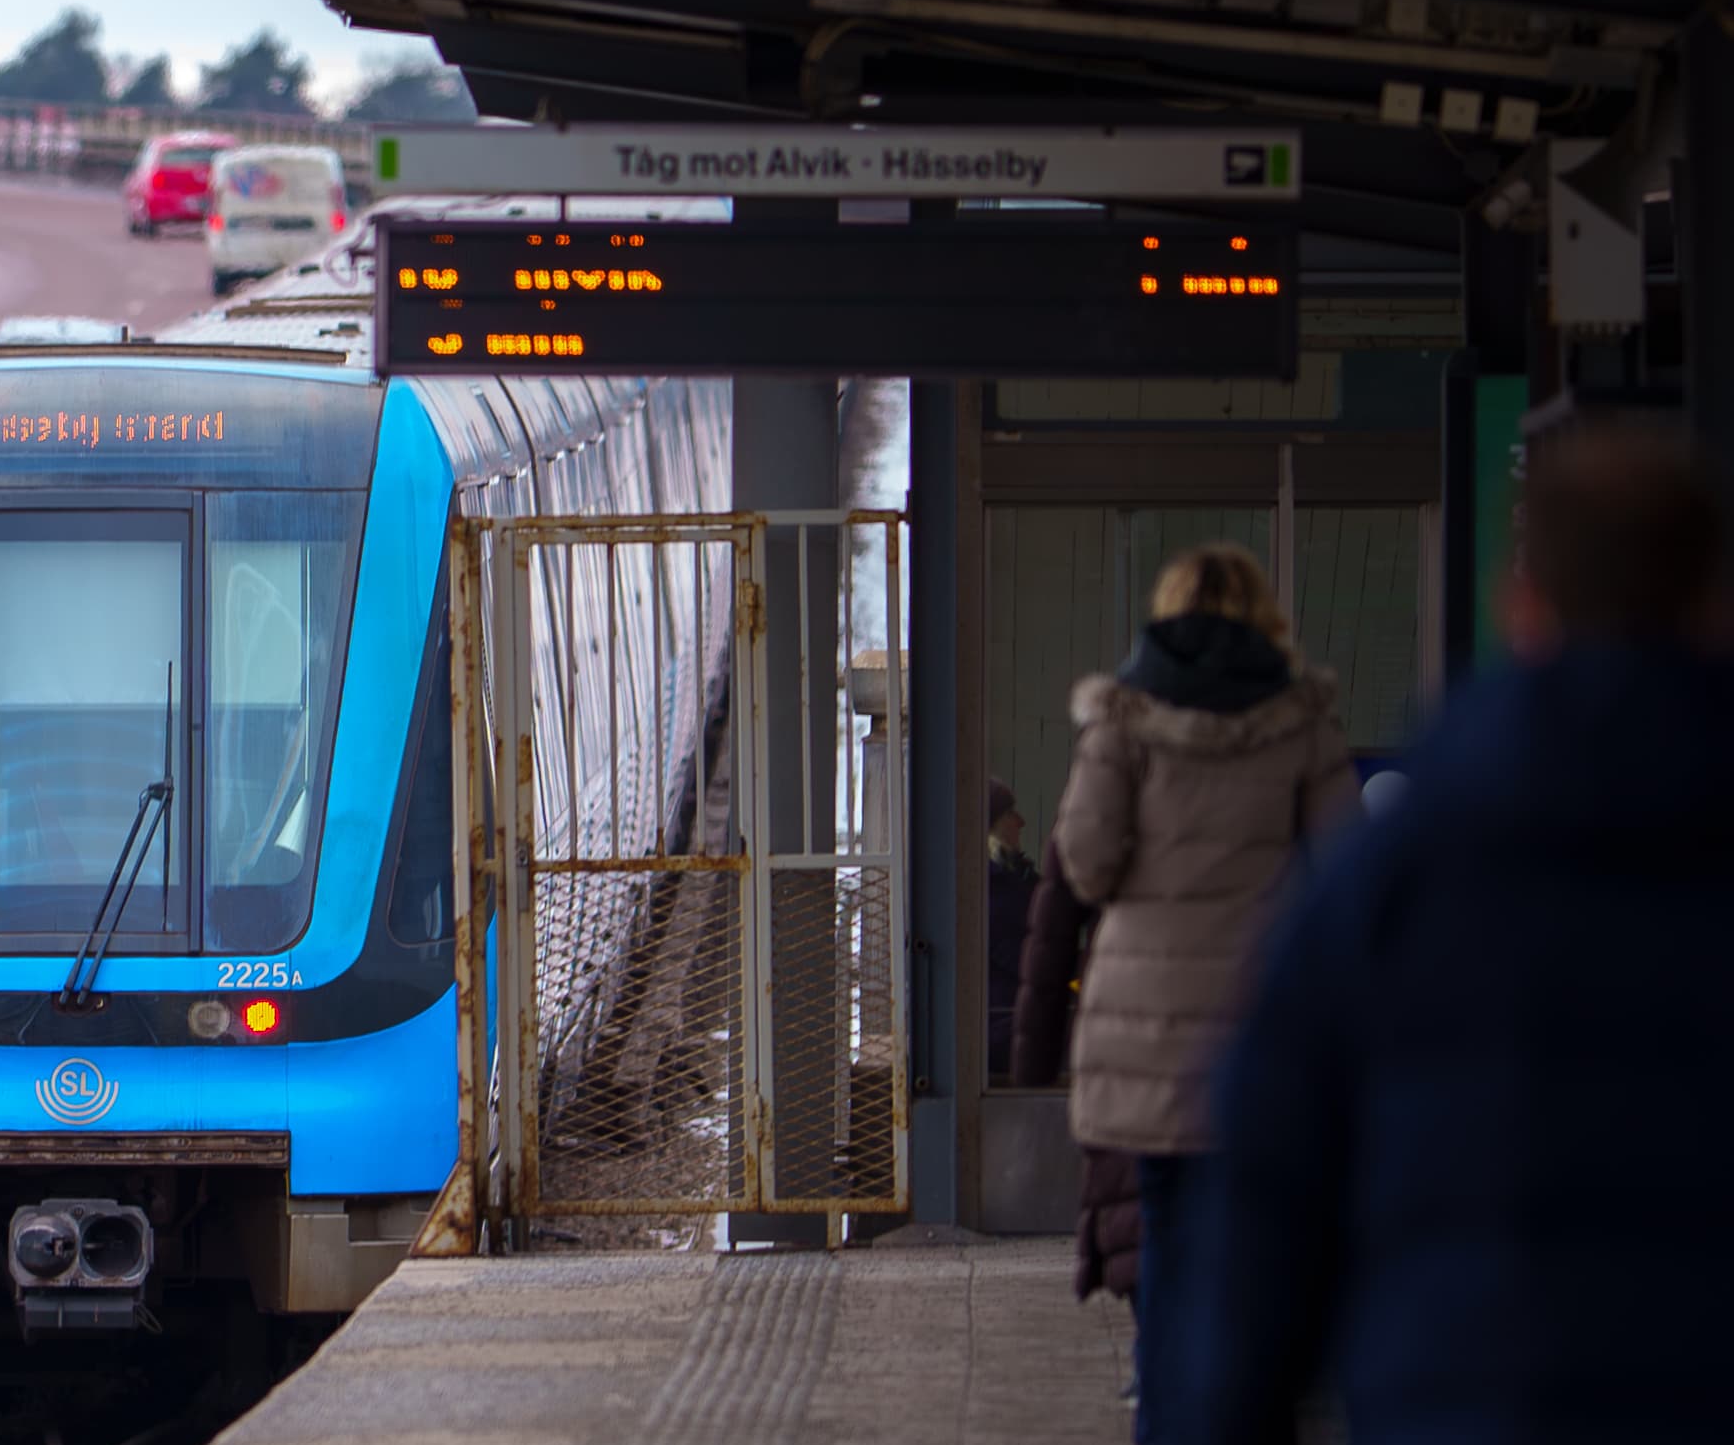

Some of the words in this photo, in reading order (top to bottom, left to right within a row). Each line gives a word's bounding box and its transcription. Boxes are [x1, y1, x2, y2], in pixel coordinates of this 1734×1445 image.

[615, 145, 681, 183] Tåg
[690, 148, 757, 177] mot
[764, 146, 851, 177] Alvik
[882, 146, 1048, 184] Hässelby
[60, 1070, 96, 1097] SL
